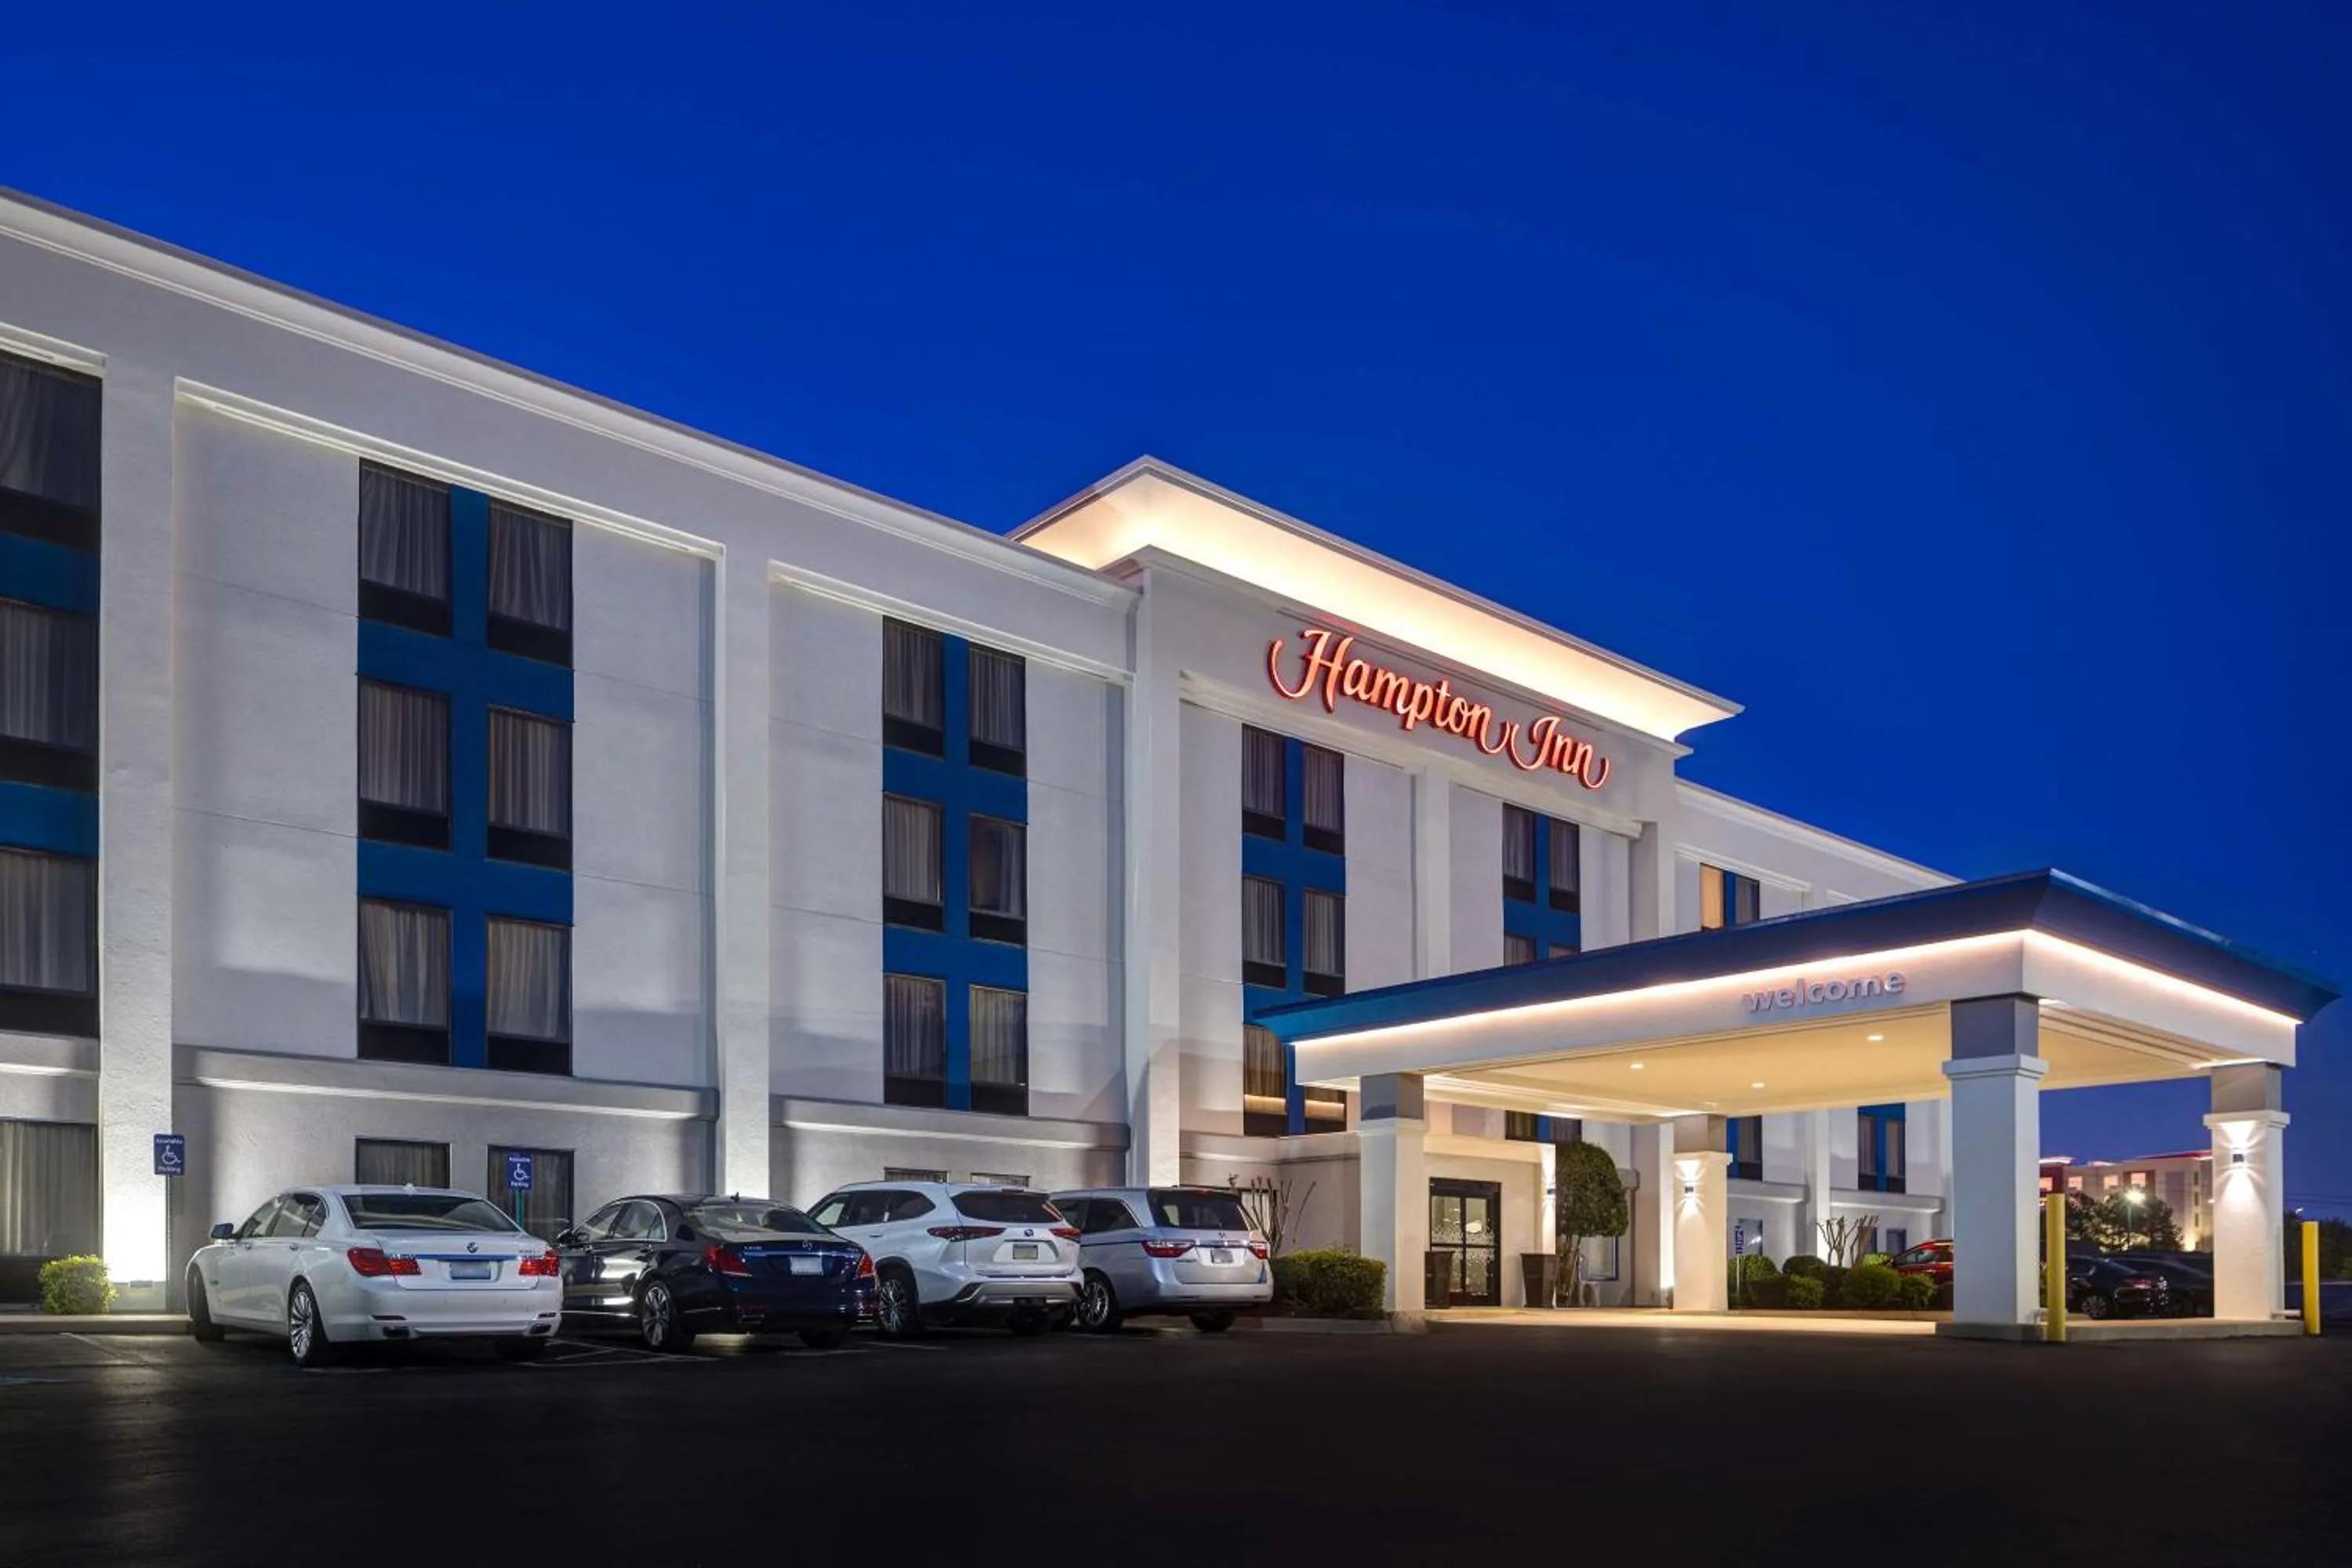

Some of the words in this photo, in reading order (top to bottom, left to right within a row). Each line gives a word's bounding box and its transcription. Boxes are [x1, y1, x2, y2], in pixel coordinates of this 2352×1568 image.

[1268, 629, 1510, 754] Hampton
[1506, 715, 1610, 789] Inn
[1743, 971, 1906, 1012] welcome
